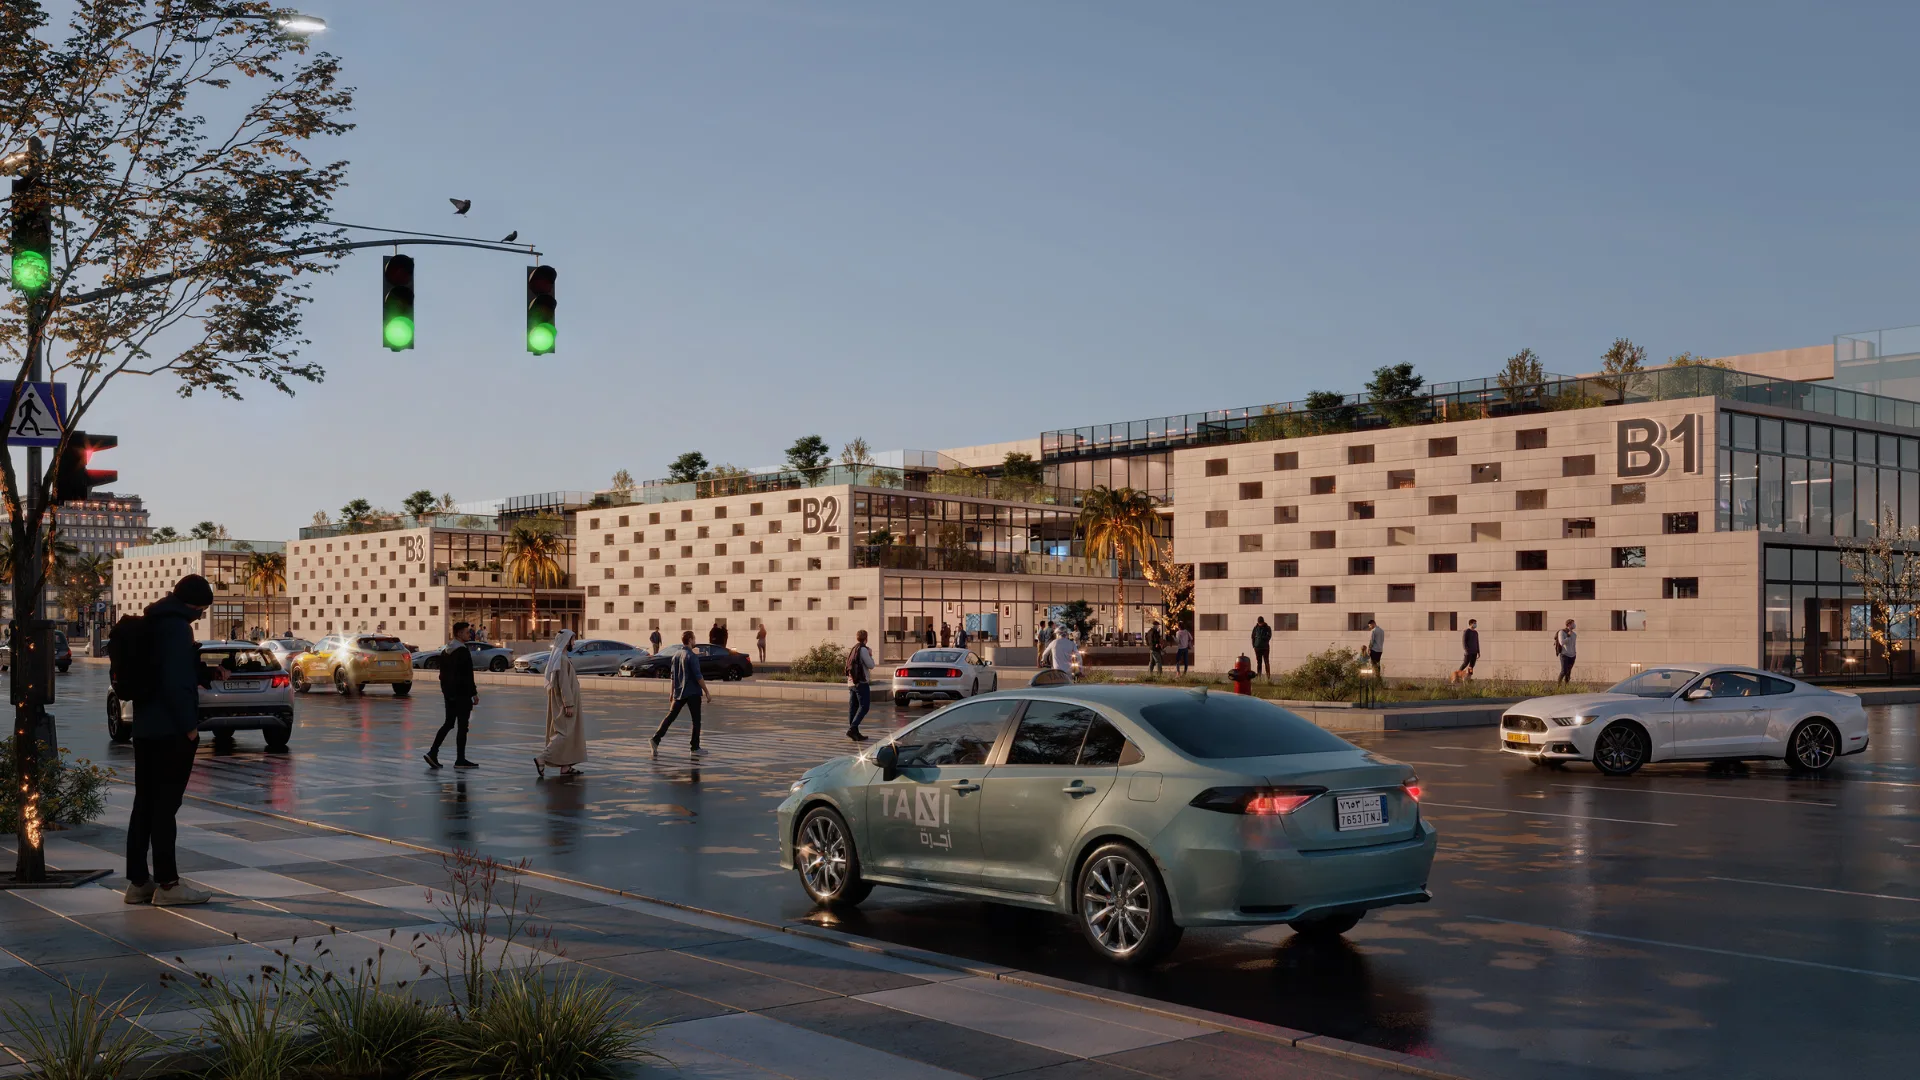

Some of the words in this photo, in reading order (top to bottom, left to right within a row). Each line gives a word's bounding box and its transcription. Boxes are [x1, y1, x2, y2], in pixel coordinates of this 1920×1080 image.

[1617, 413, 1698, 478] B1
[803, 496, 839, 534] B2
[406, 535, 424, 562] B3
[96, 602, 106, 612] P
[1341, 814, 1362, 825] 7653
[1365, 812, 1381, 823] TNJ
